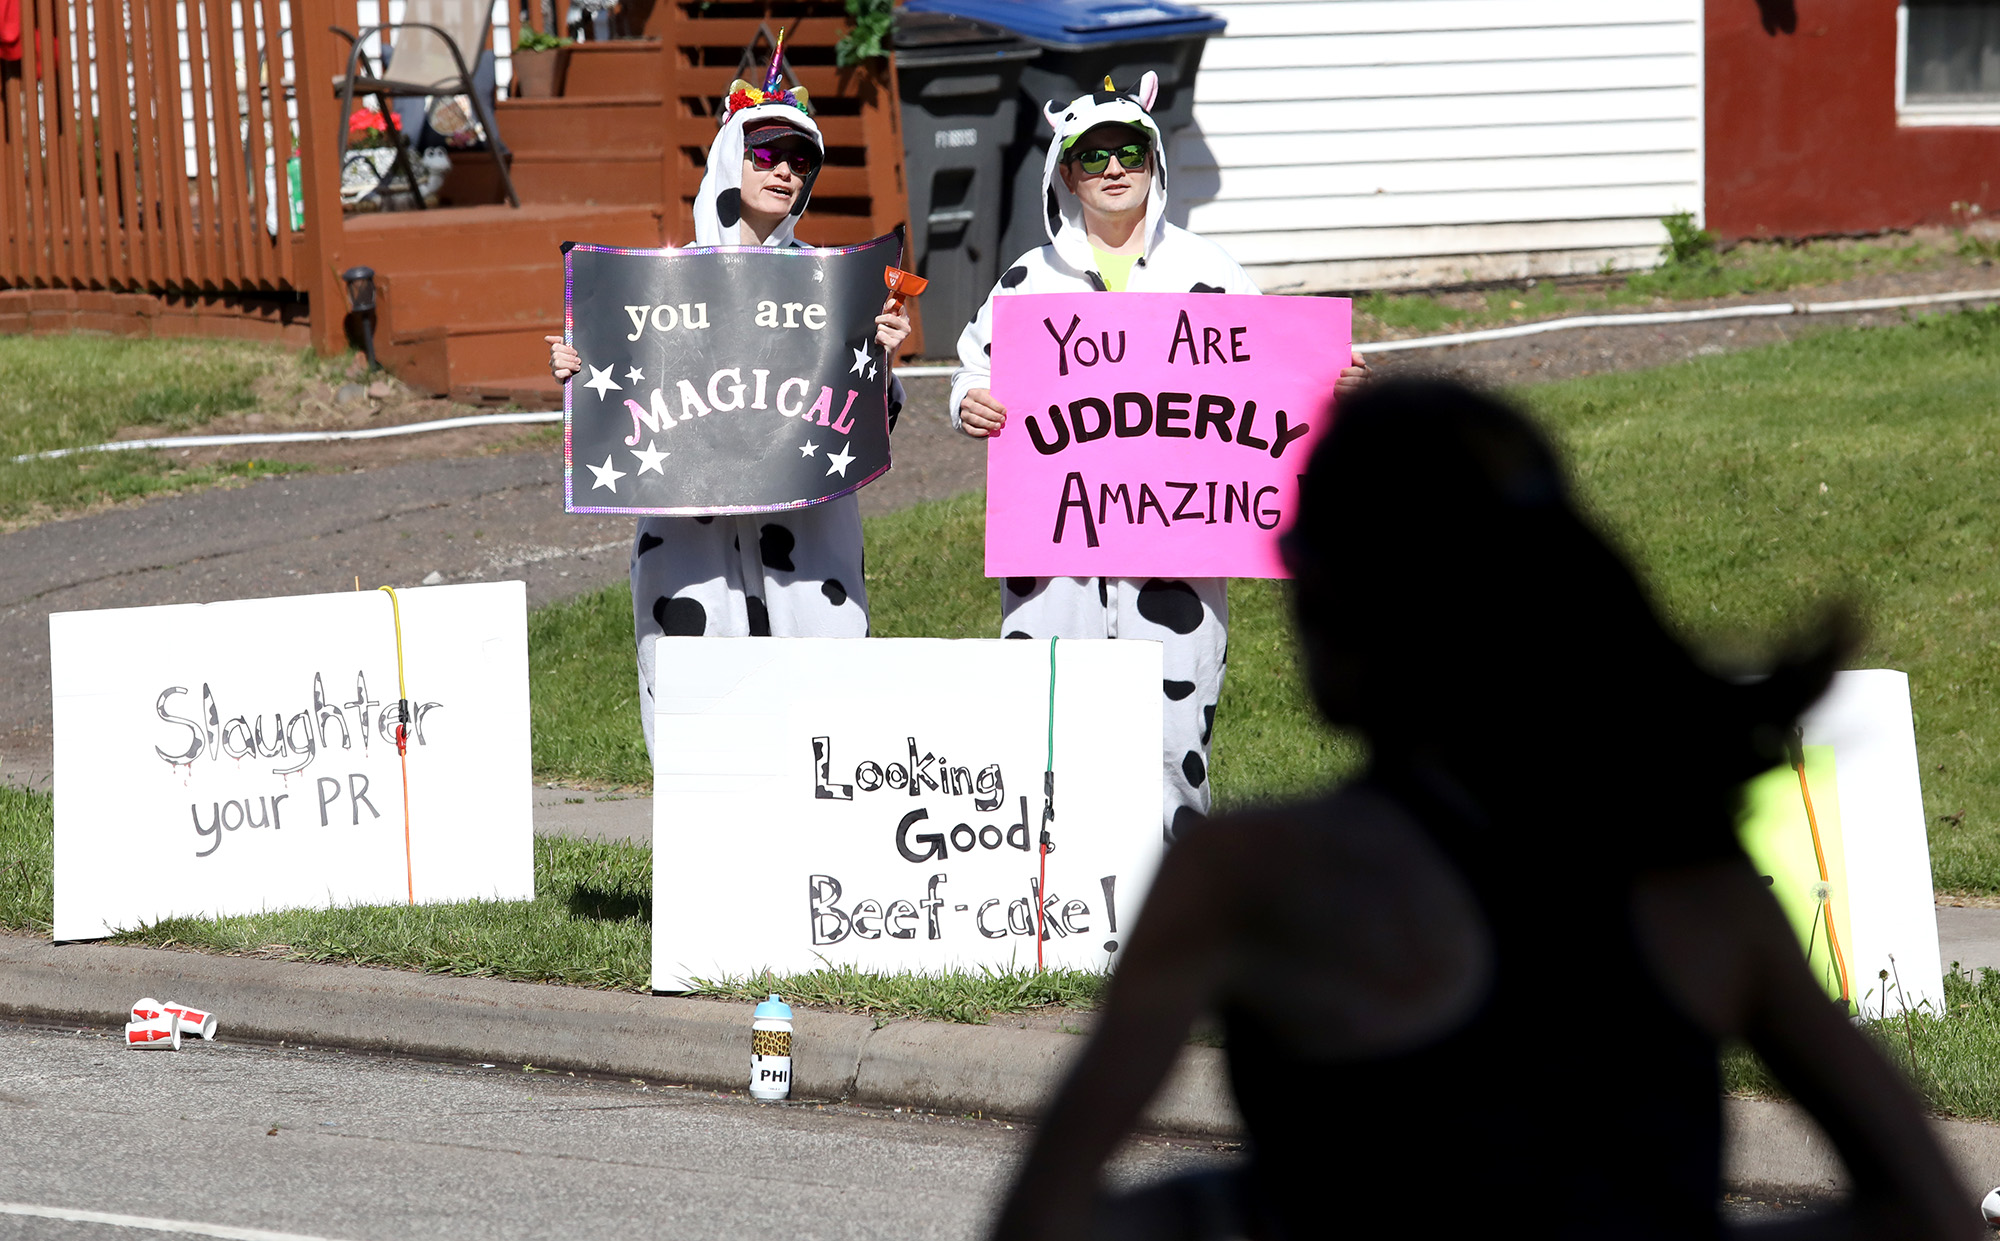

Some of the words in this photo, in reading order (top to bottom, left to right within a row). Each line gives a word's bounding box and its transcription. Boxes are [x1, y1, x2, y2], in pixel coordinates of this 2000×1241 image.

[624, 301, 711, 342] you
[754, 300, 828, 330] are
[623, 367, 859, 446] MAGICAL
[1024, 391, 1310, 459] UDDERLY
[1052, 472, 1307, 548] AMAZING
[155, 670, 443, 774] Slaughter
[812, 736, 1005, 812] Looking
[192, 794, 289, 857] your
[317, 773, 380, 827] PR
[809, 873, 1119, 952] Beef-cake!
